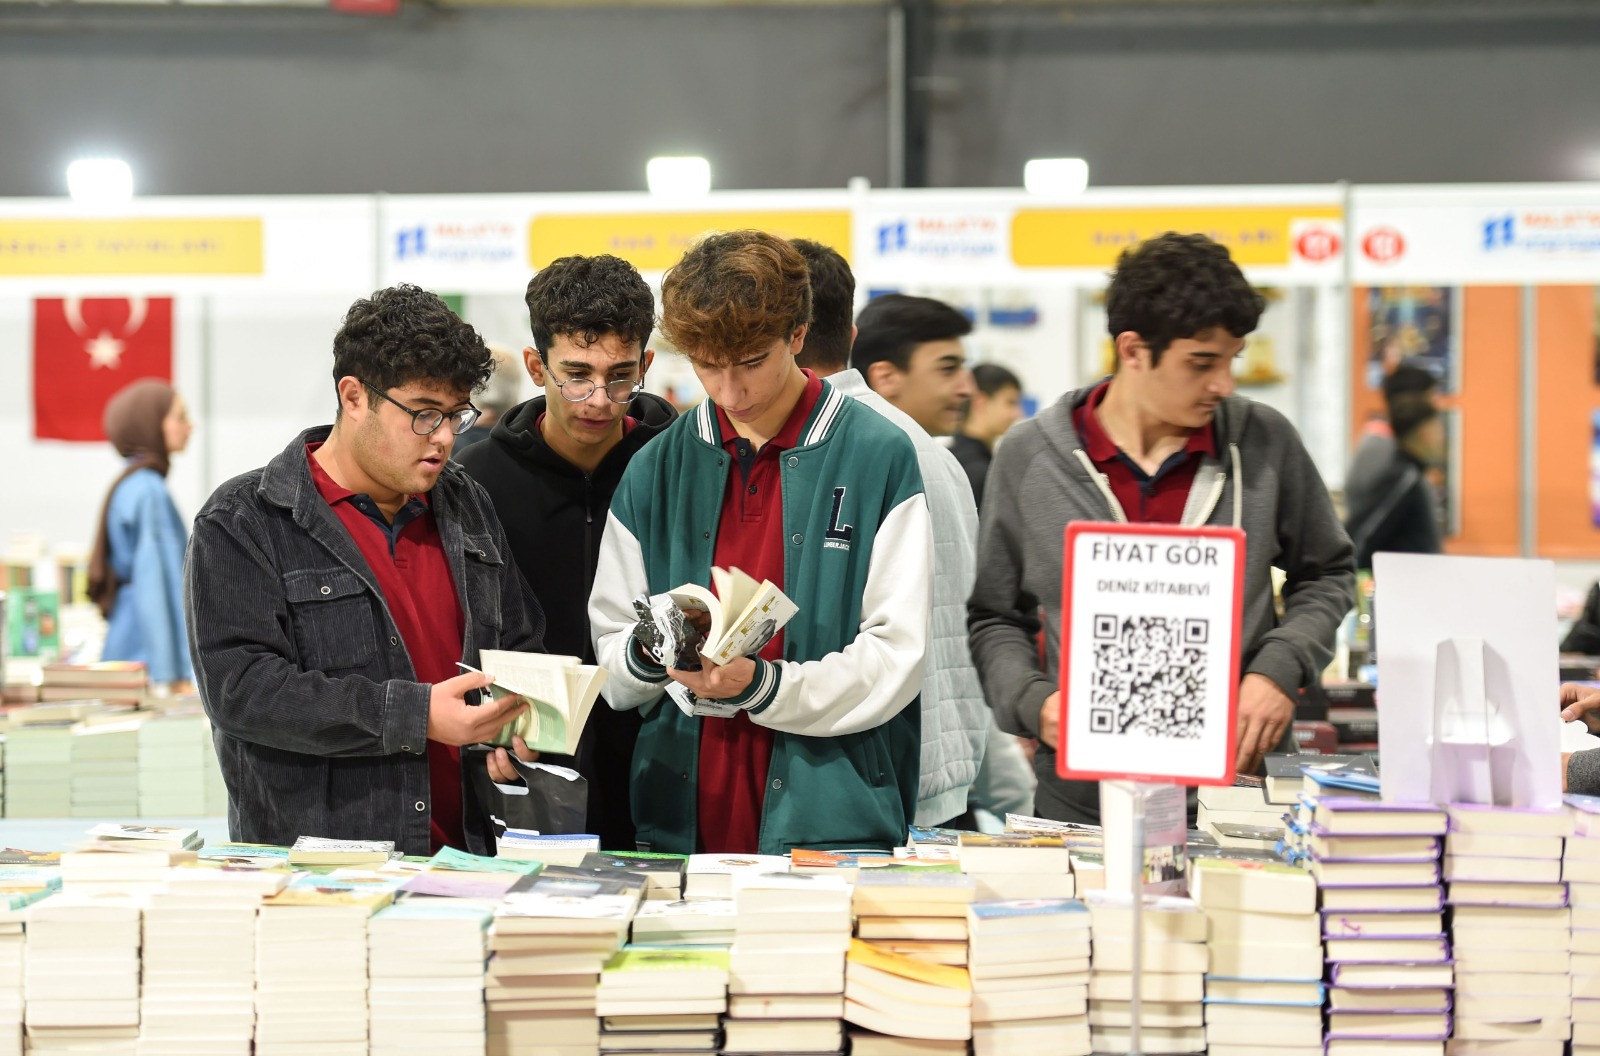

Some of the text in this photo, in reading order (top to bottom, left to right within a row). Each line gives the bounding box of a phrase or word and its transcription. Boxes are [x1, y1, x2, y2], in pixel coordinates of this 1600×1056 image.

[825, 487, 853, 542] L
[1092, 537, 1219, 567] FİYAT GÖR
[1097, 578, 1211, 597] DENİZ KİTABEVİ
